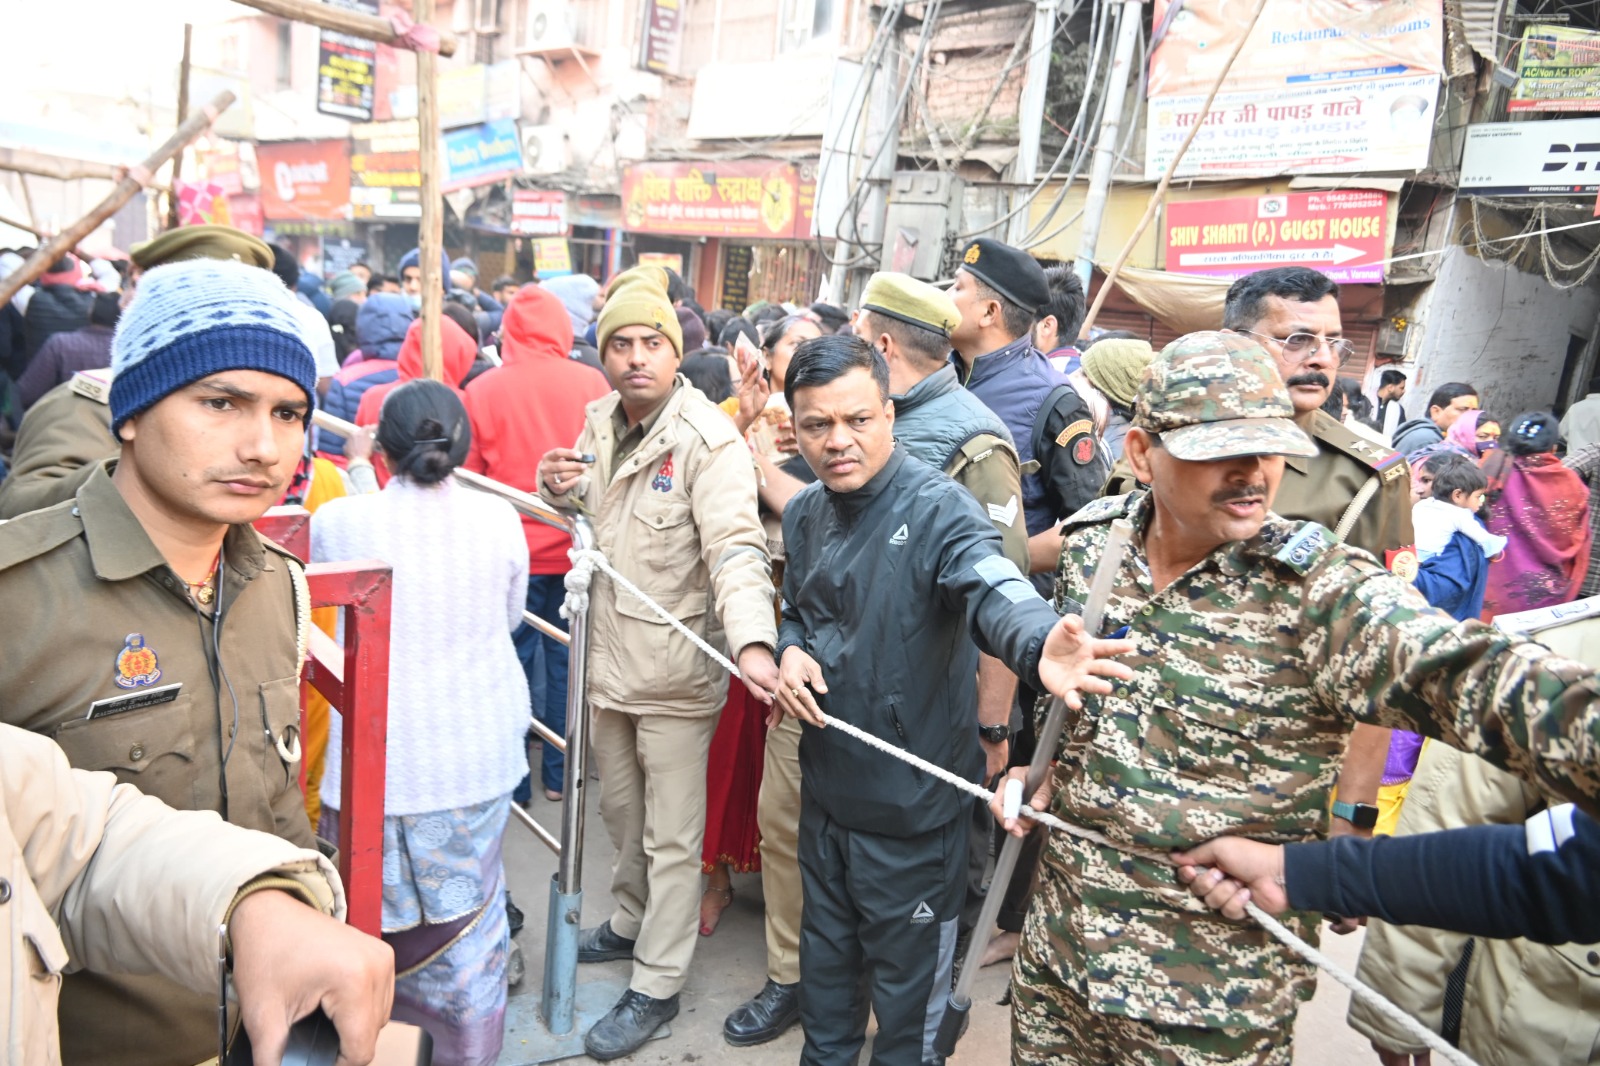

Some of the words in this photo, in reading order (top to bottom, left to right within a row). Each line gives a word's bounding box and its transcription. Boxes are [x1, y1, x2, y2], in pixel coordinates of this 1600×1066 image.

[1272, 26, 1350, 44] Restaura
[1555, 68, 1567, 77] AC
[1569, 67, 1596, 78] ROOM
[1234, 103, 1258, 123] जी
[1321, 95, 1364, 117] वाले
[642, 171, 671, 201] शिव
[1170, 226, 1199, 247] SHIV
[1202, 223, 1248, 245] SHAKTI
[1252, 220, 1276, 247] (P.)
[1280, 219, 1326, 242] GUEST
[1329, 216, 1380, 240] HOUSE
[1351, 268, 1381, 280] Varanasi
